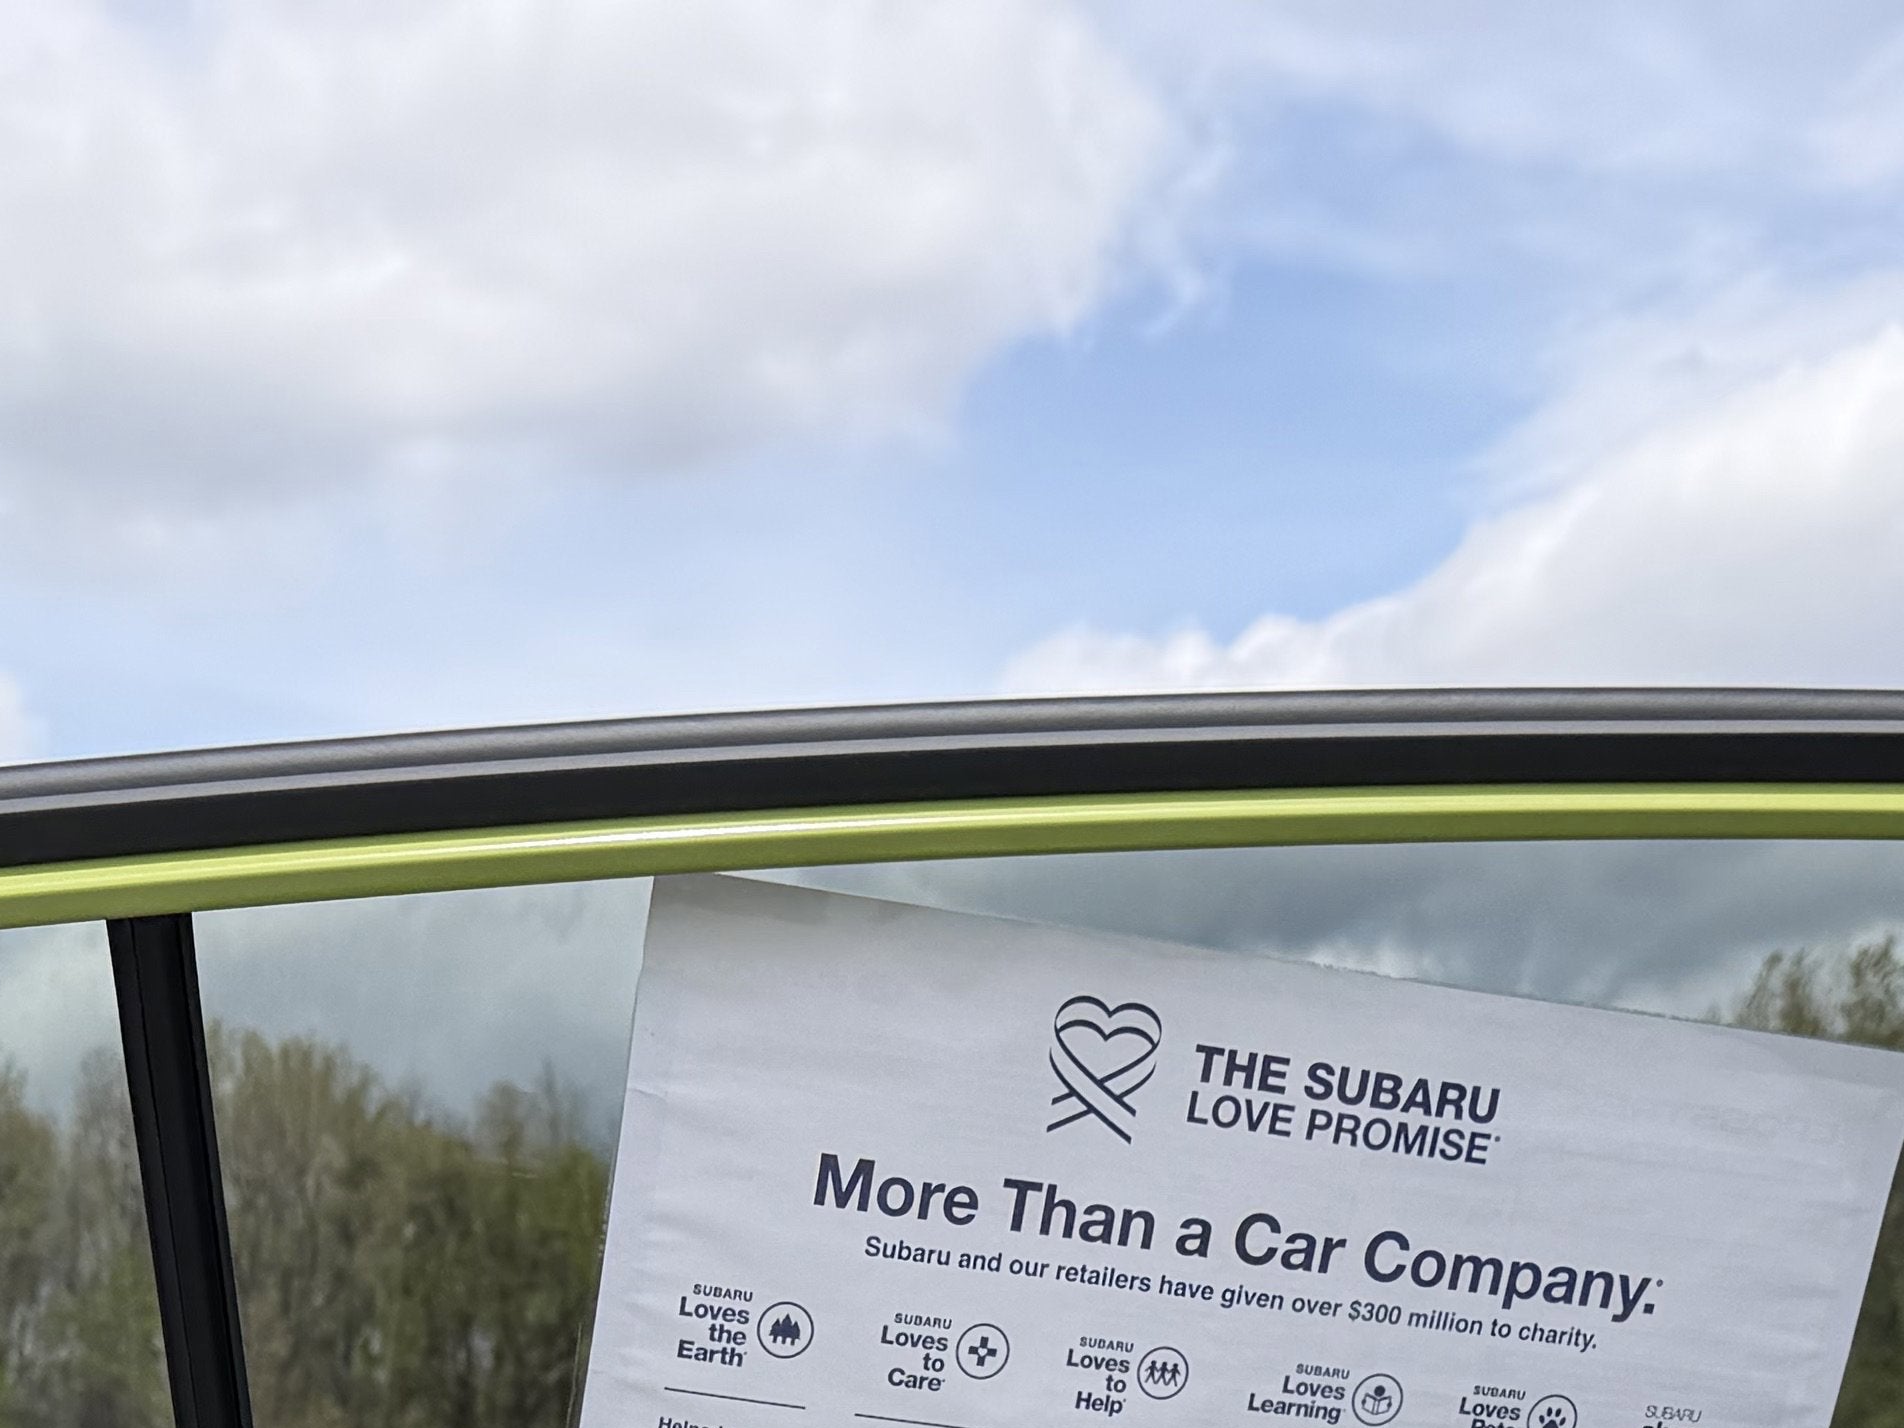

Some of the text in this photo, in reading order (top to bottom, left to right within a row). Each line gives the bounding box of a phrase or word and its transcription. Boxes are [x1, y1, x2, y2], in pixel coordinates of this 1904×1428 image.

[1195, 1043, 1500, 1124] THE SUBARU
[1187, 1091, 1295, 1138] LOVE
[813, 1153, 979, 1226] More
[1003, 1178, 1155, 1250] Than
[1175, 1216, 1213, 1258] a
[1235, 1213, 1347, 1274] Car
[693, 1284, 753, 1302] SUBARU
[864, 1235, 1598, 1352] Subaru and our retailers have given over $300 million to charity.
[679, 1296, 750, 1324] Loves
[894, 1312, 952, 1330] SUBARU
[708, 1324, 746, 1345] the
[880, 1325, 948, 1351] Loves
[1080, 1336, 1134, 1353] SUBARU
[922, 1352, 945, 1372] to
[1066, 1349, 1130, 1373] Loves
[1296, 1363, 1350, 1379] SUBARU
[1105, 1375, 1127, 1393] to
[1282, 1375, 1345, 1400] Loves
[1473, 1385, 1526, 1400] SUBARU
[1458, 1397, 1521, 1421] Loves
[1645, 1405, 1702, 1423] SUBARU
